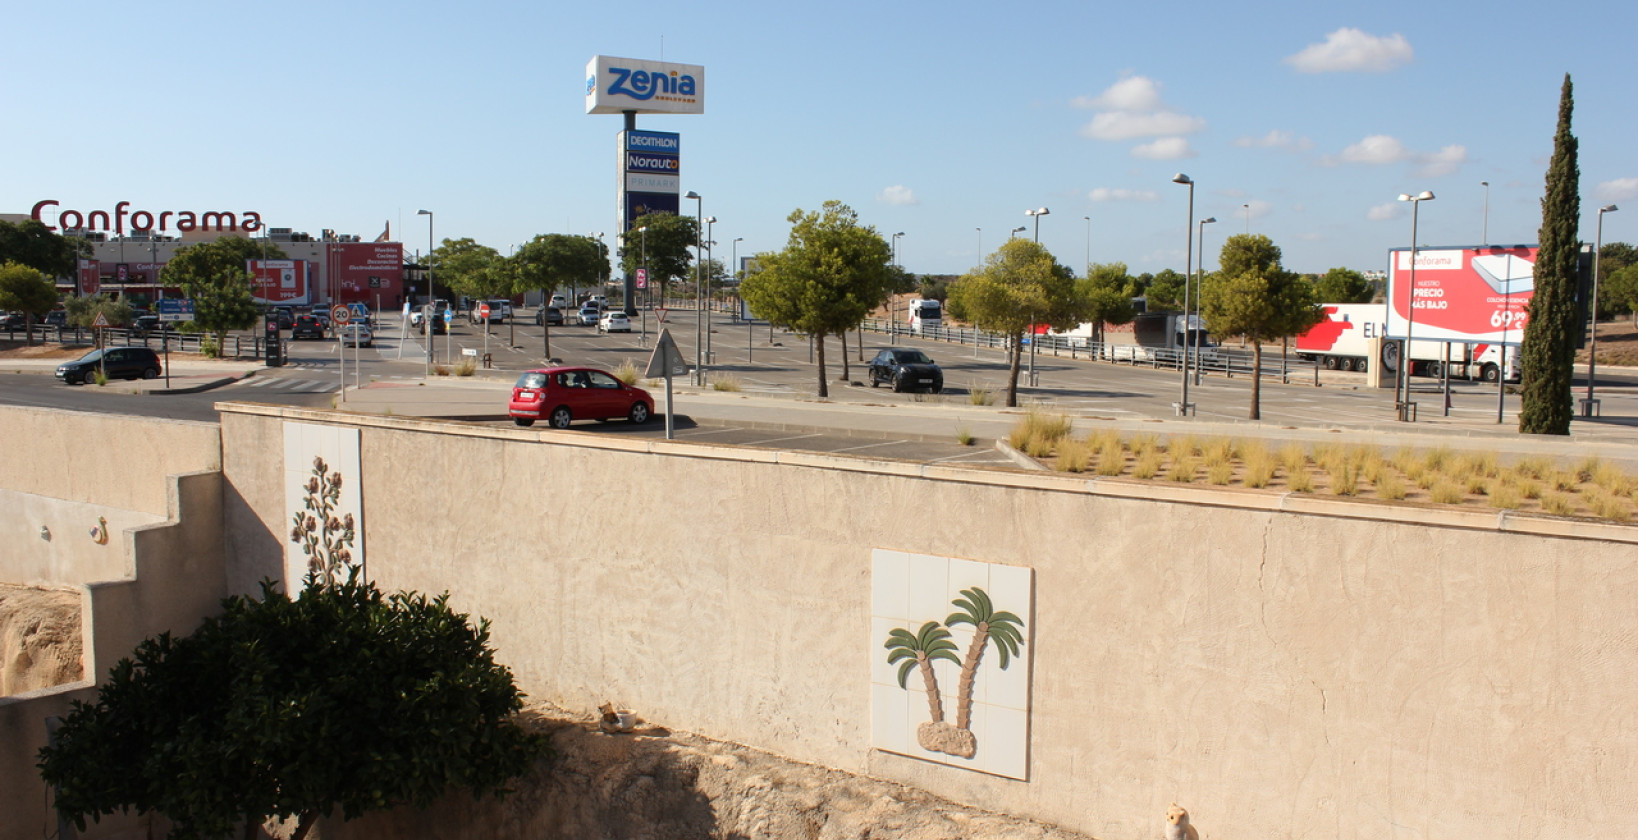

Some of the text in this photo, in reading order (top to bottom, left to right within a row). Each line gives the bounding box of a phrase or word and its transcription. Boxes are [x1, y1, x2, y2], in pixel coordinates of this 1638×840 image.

[630, 135, 677, 148] DECATHLON
[629, 155, 678, 170] Norauto
[631, 177, 676, 188] PRIMARK
[31, 199, 262, 234] Conforama
[1413, 287, 1444, 298] PRECIO
[1426, 300, 1448, 310] BAJO
[1363, 322, 1378, 338] EL
